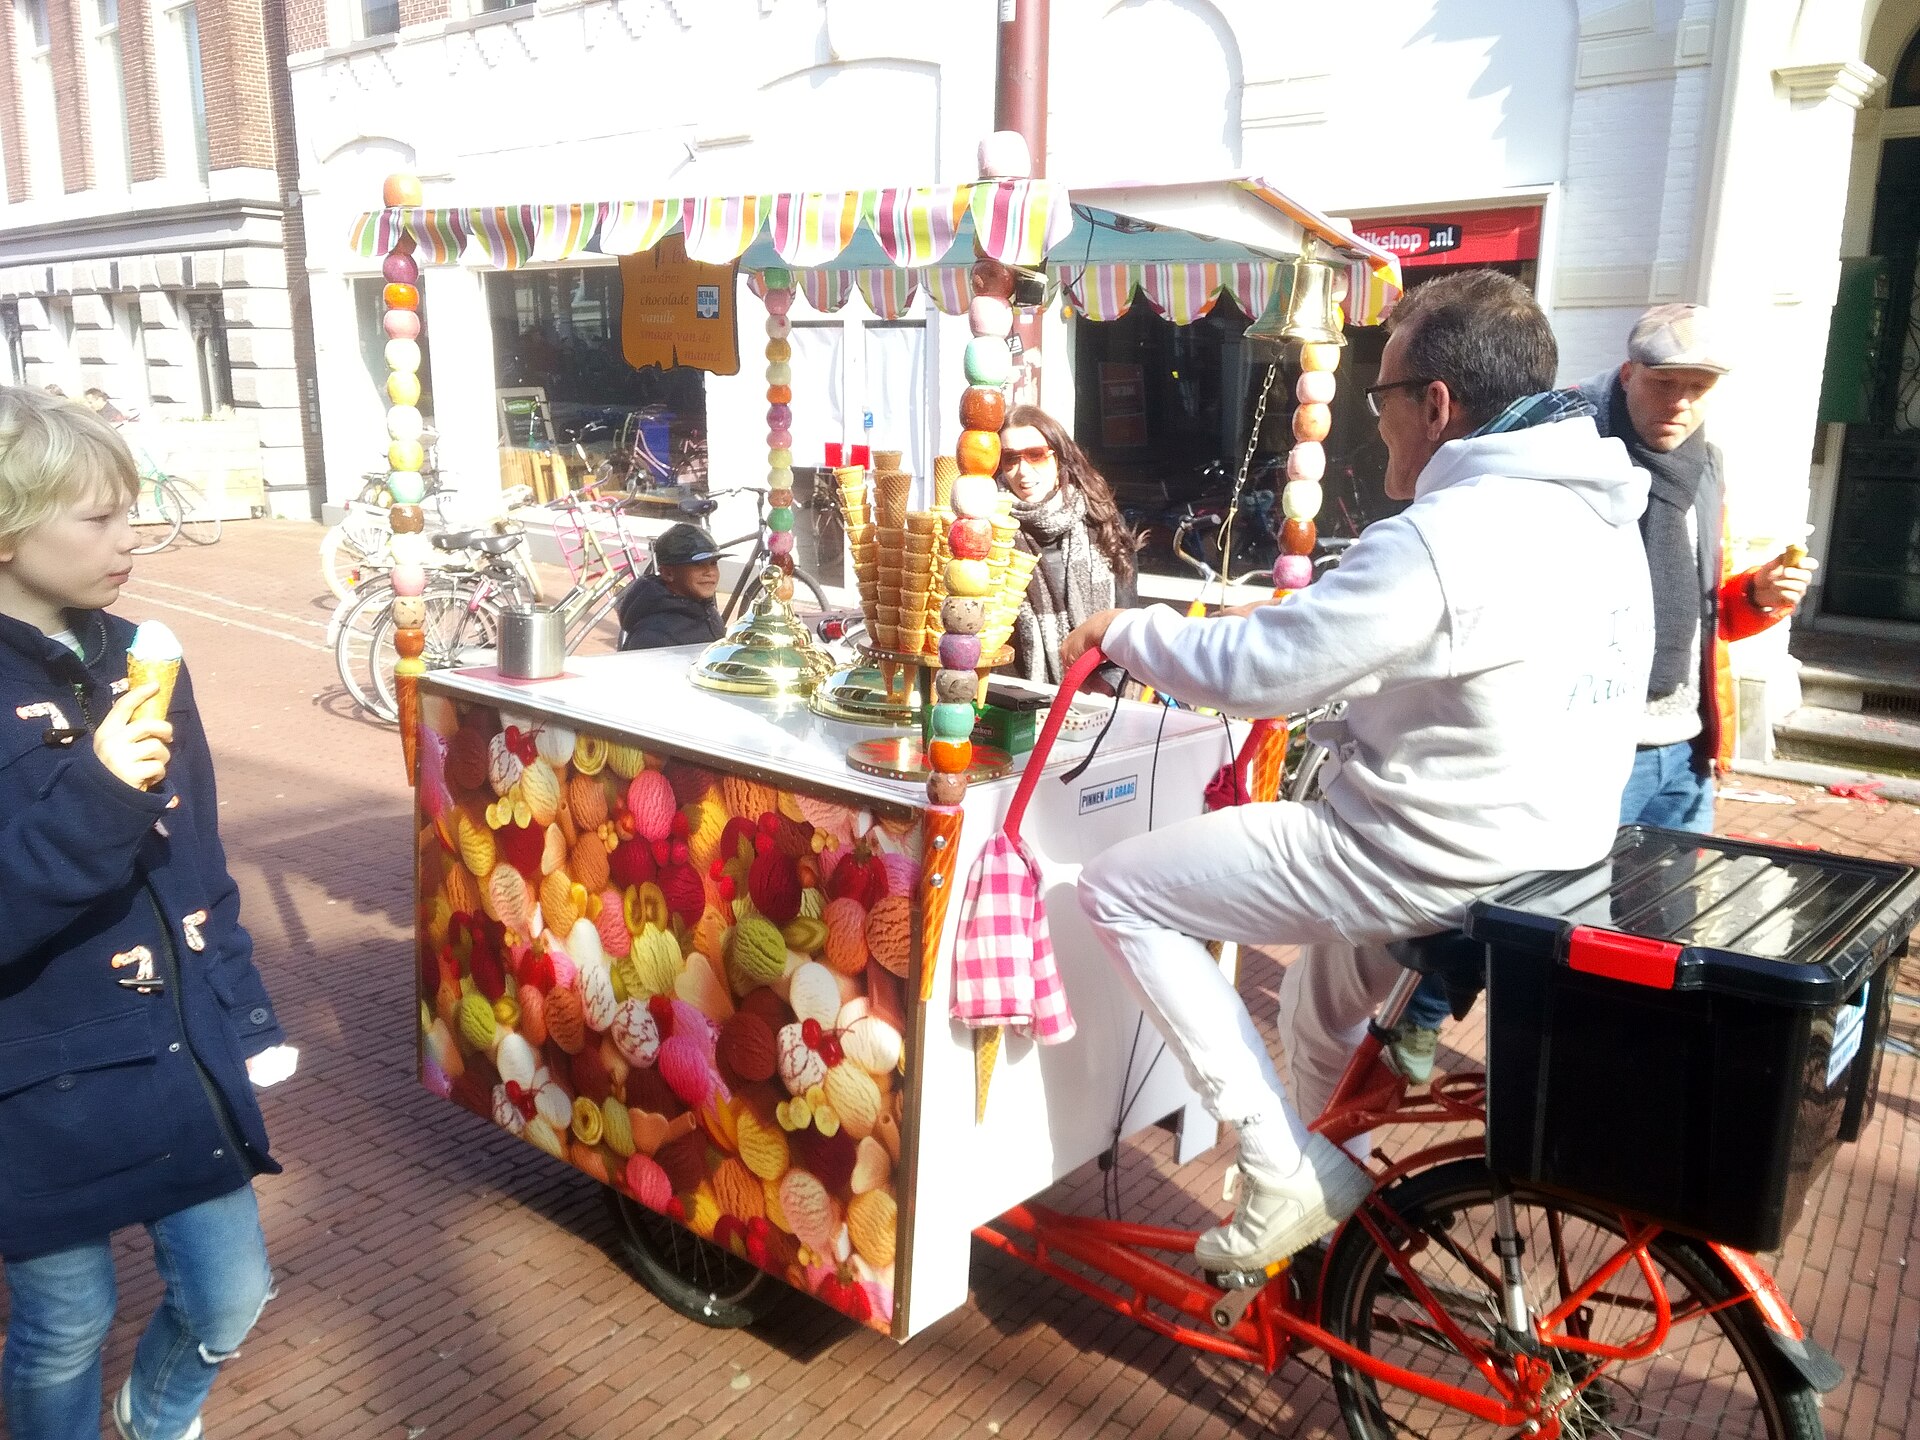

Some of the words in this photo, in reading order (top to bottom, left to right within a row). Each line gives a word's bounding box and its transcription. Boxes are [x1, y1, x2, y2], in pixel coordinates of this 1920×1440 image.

[640, 291, 689, 306] chocolade
[1081, 791, 1105, 808] PINNEN
[1105, 787, 1114, 801] JA
[1114, 782, 1135, 798] GRAAG
